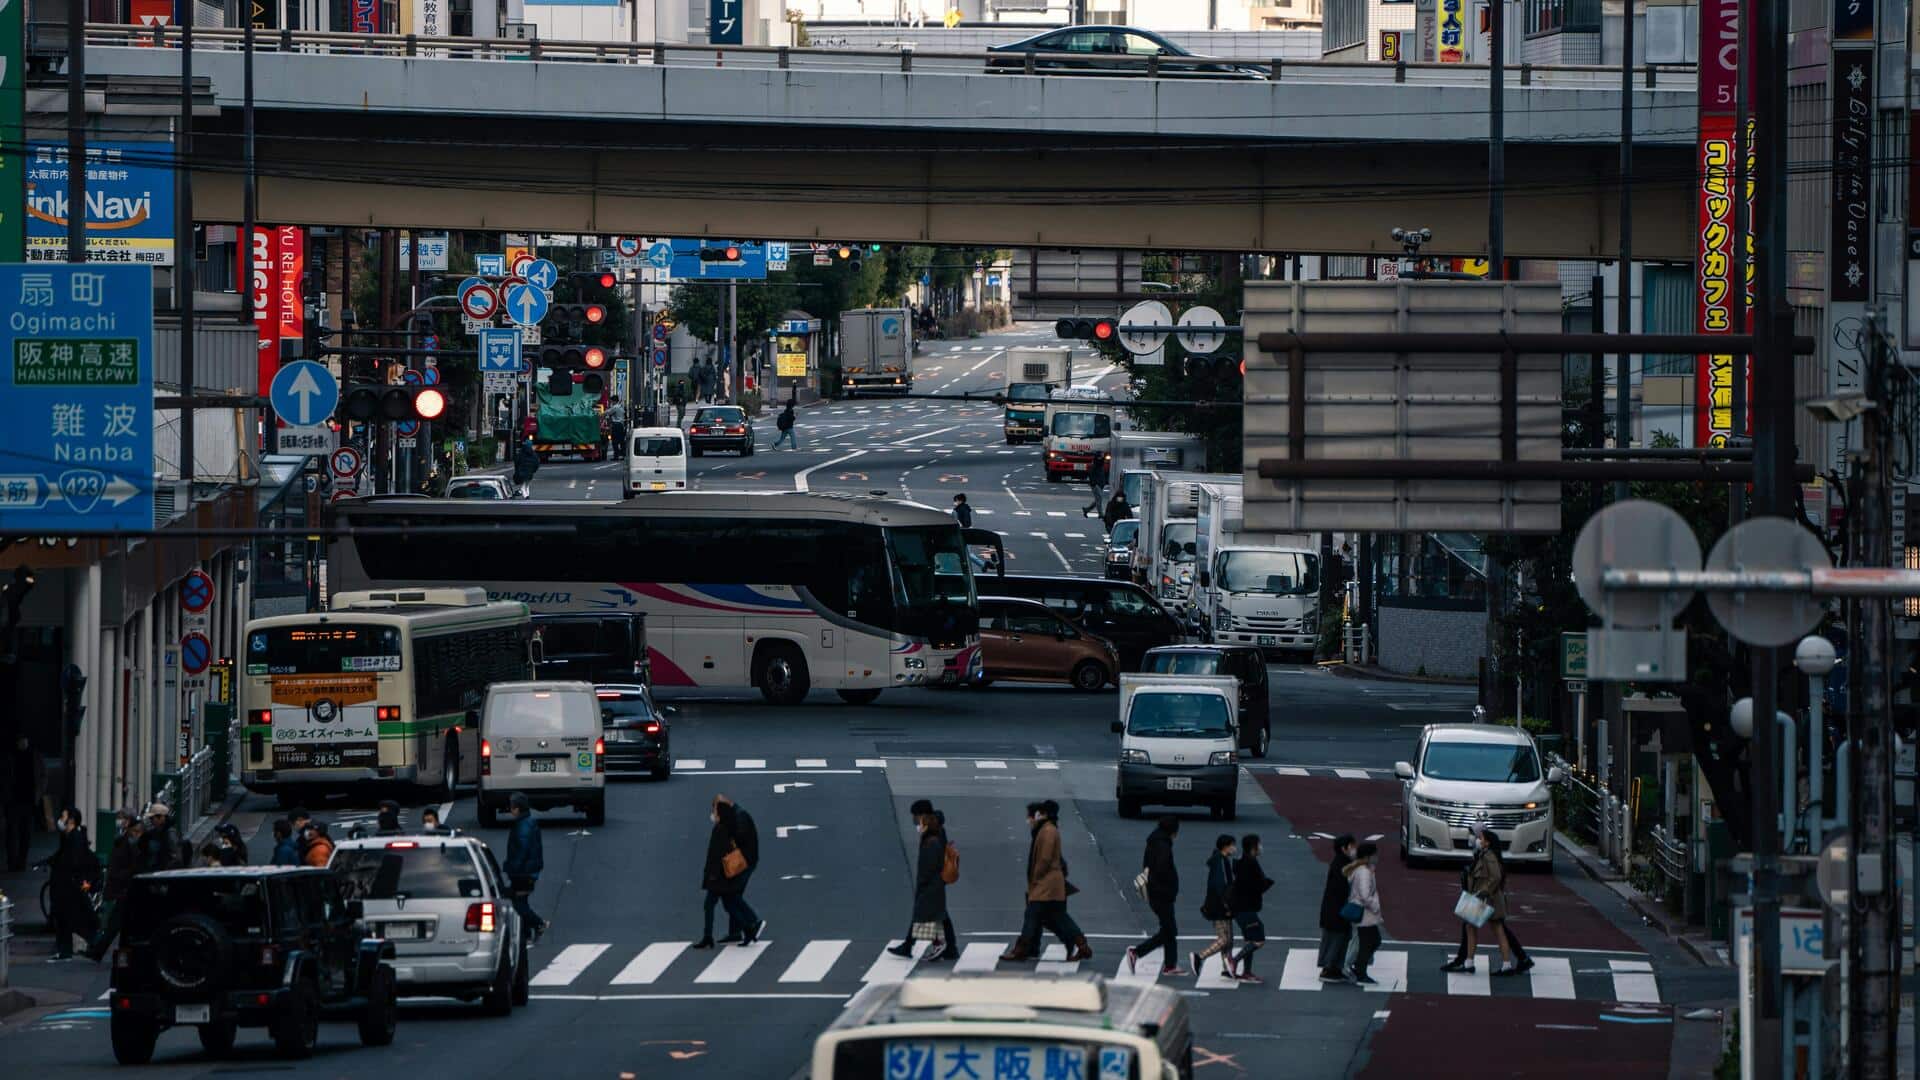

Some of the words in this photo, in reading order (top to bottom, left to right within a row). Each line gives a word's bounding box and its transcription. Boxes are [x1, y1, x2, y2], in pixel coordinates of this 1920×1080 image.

[1703, 140, 1730, 332] コミックカフェ
[281, 251, 294, 274] REI
[20, 272, 105, 306] 扇町
[281, 280, 294, 328] HOTEL
[10, 312, 116, 335] Ogimachi
[18, 342, 134, 367] 阪神高速
[18, 368, 82, 382] HANSHIN
[86, 368, 135, 382] EXPWY
[51, 403, 139, 437] 難波
[54, 443, 133, 462] Nanba
[0, 481, 28, 502] 筋
[66, 477, 99, 497] 423
[891, 1045, 932, 1080] 37
[944, 1043, 1085, 1080] 大阪駅
